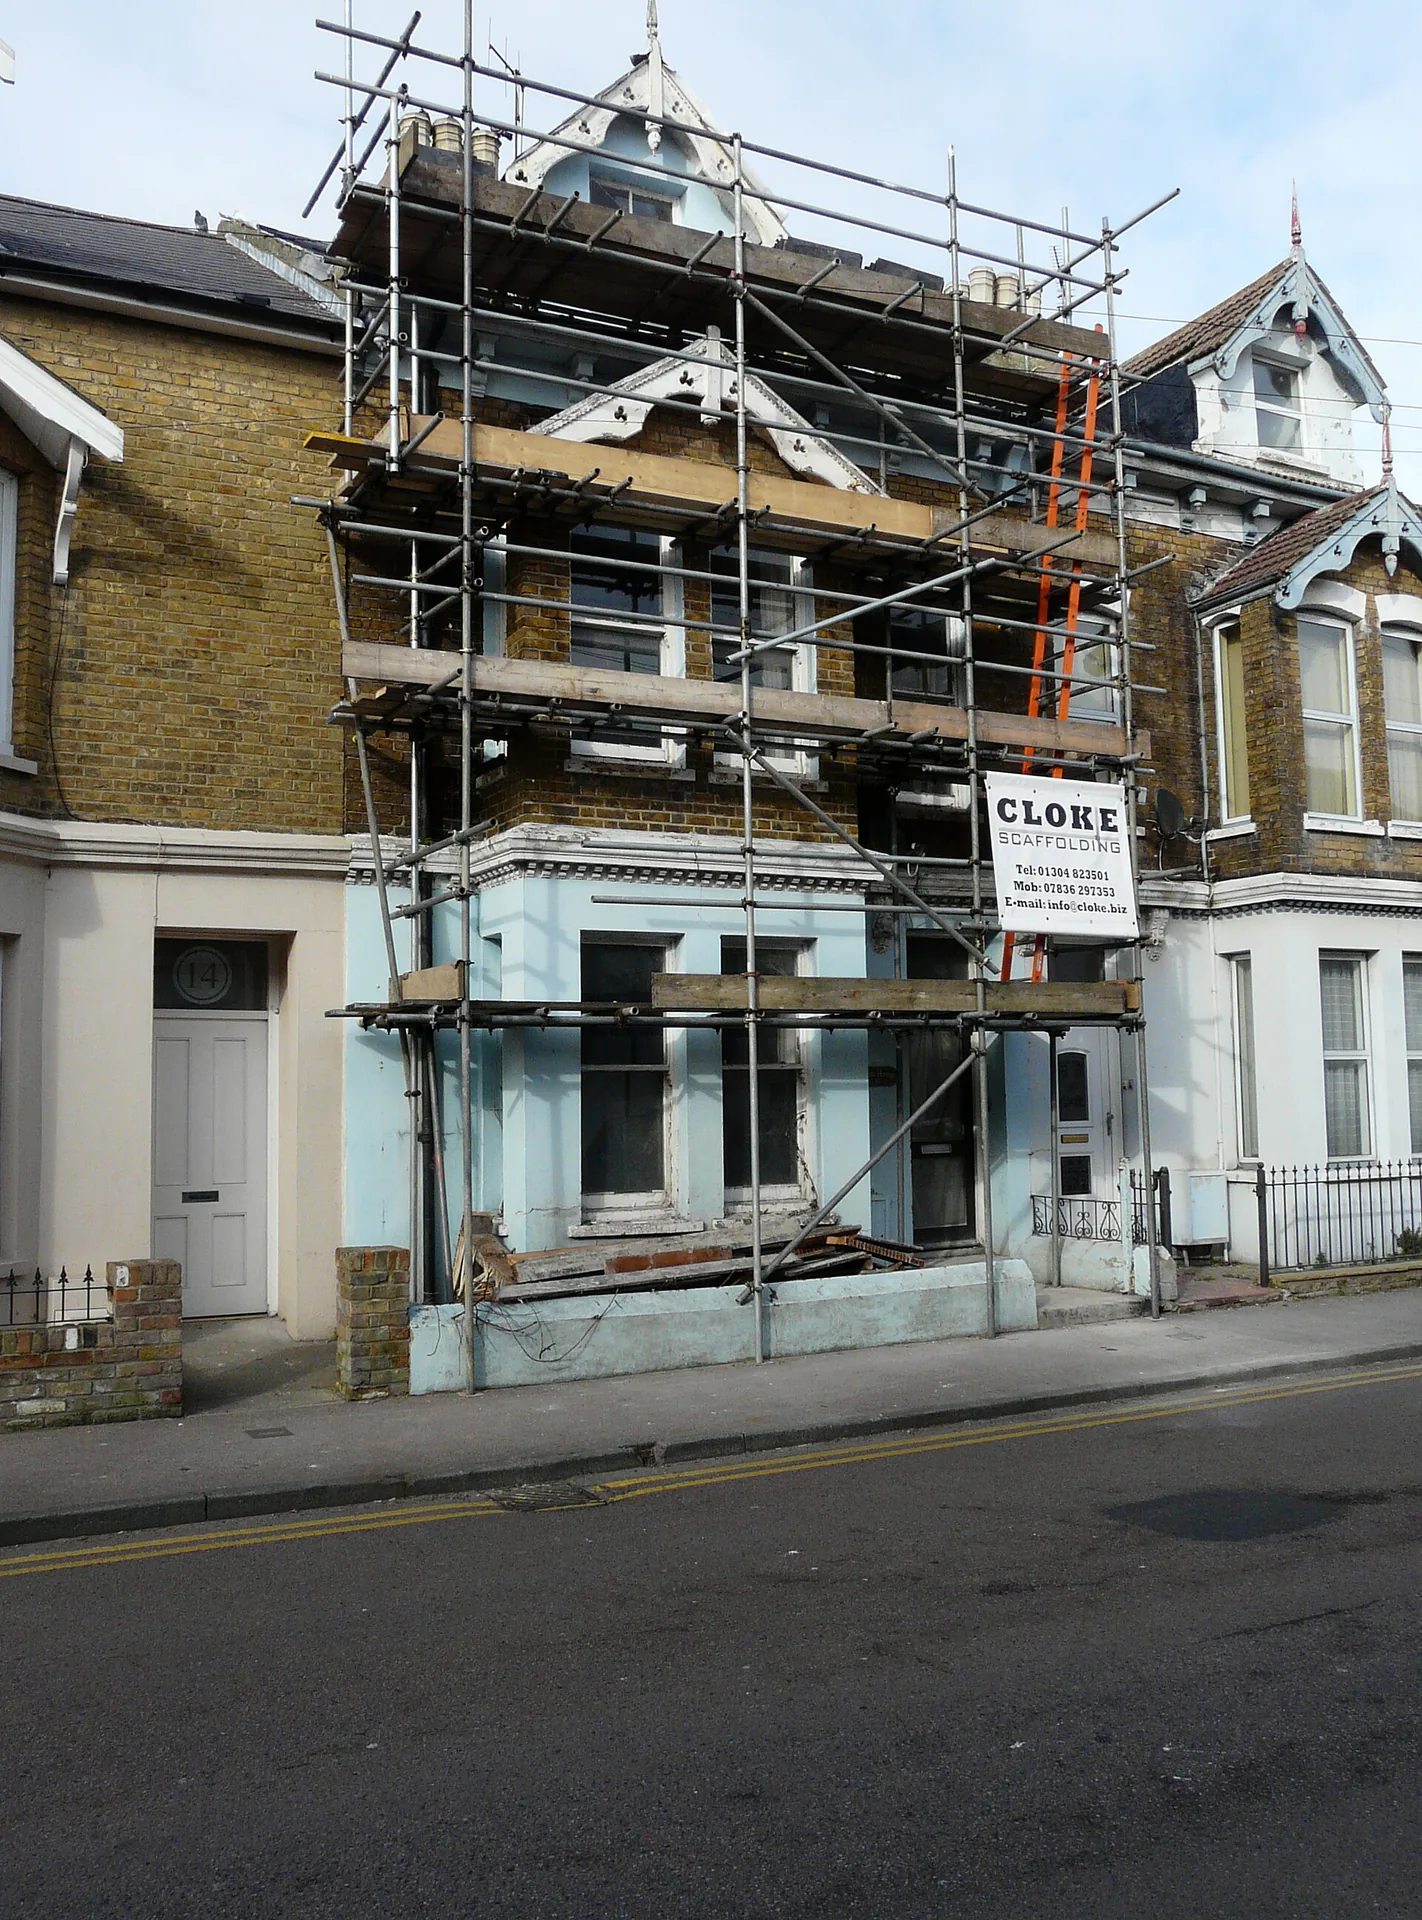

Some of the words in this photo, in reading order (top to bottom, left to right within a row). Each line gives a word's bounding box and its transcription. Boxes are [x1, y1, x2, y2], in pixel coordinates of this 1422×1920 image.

[997, 797, 1118, 832] CLOKE
[998, 832, 1121, 854] SCAFFOLDING
[1016, 864, 1036, 876] Tel:
[1038, 866, 1069, 878] 01304
[1072, 868, 1109, 881] 823501
[1013, 881, 1042, 893] Mob:
[1044, 884, 1076, 895] 07836
[1078, 885, 1115, 898] 297353
[1047, 900, 1128, 914] info@cloke.biz
[188, 962, 218, 989] 14
